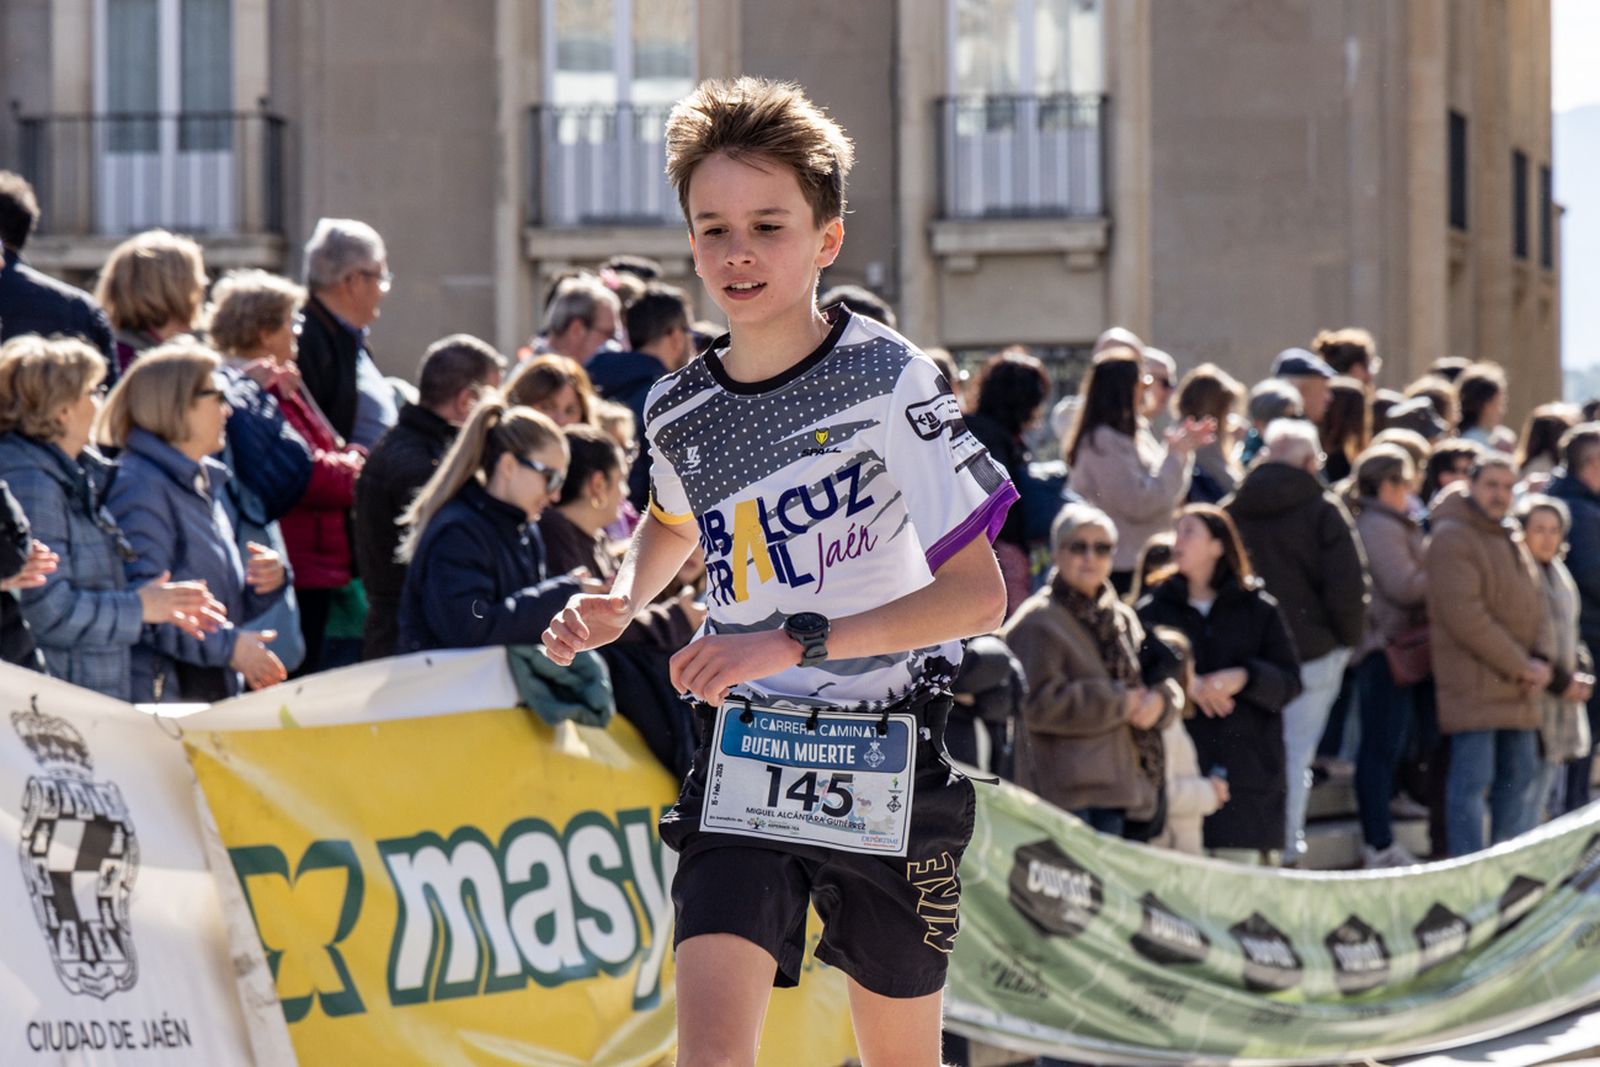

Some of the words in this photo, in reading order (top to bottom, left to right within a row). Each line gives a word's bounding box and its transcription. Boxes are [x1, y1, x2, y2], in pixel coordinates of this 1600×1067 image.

[815, 522, 878, 594] Jaén
[819, 724, 888, 739] CAMINAT
[741, 735, 790, 760] BUENA
[794, 742, 856, 764] MUERTE
[766, 765, 854, 818] 145
[745, 807, 775, 817] MIGUEL
[777, 812, 825, 824] ALCÁNTARA
[826, 818, 866, 831] GUTIÉRREZ
[27, 1020, 107, 1052] CIUDAD
[108, 1020, 137, 1050] DE
[141, 1010, 192, 1048] JAÉN
